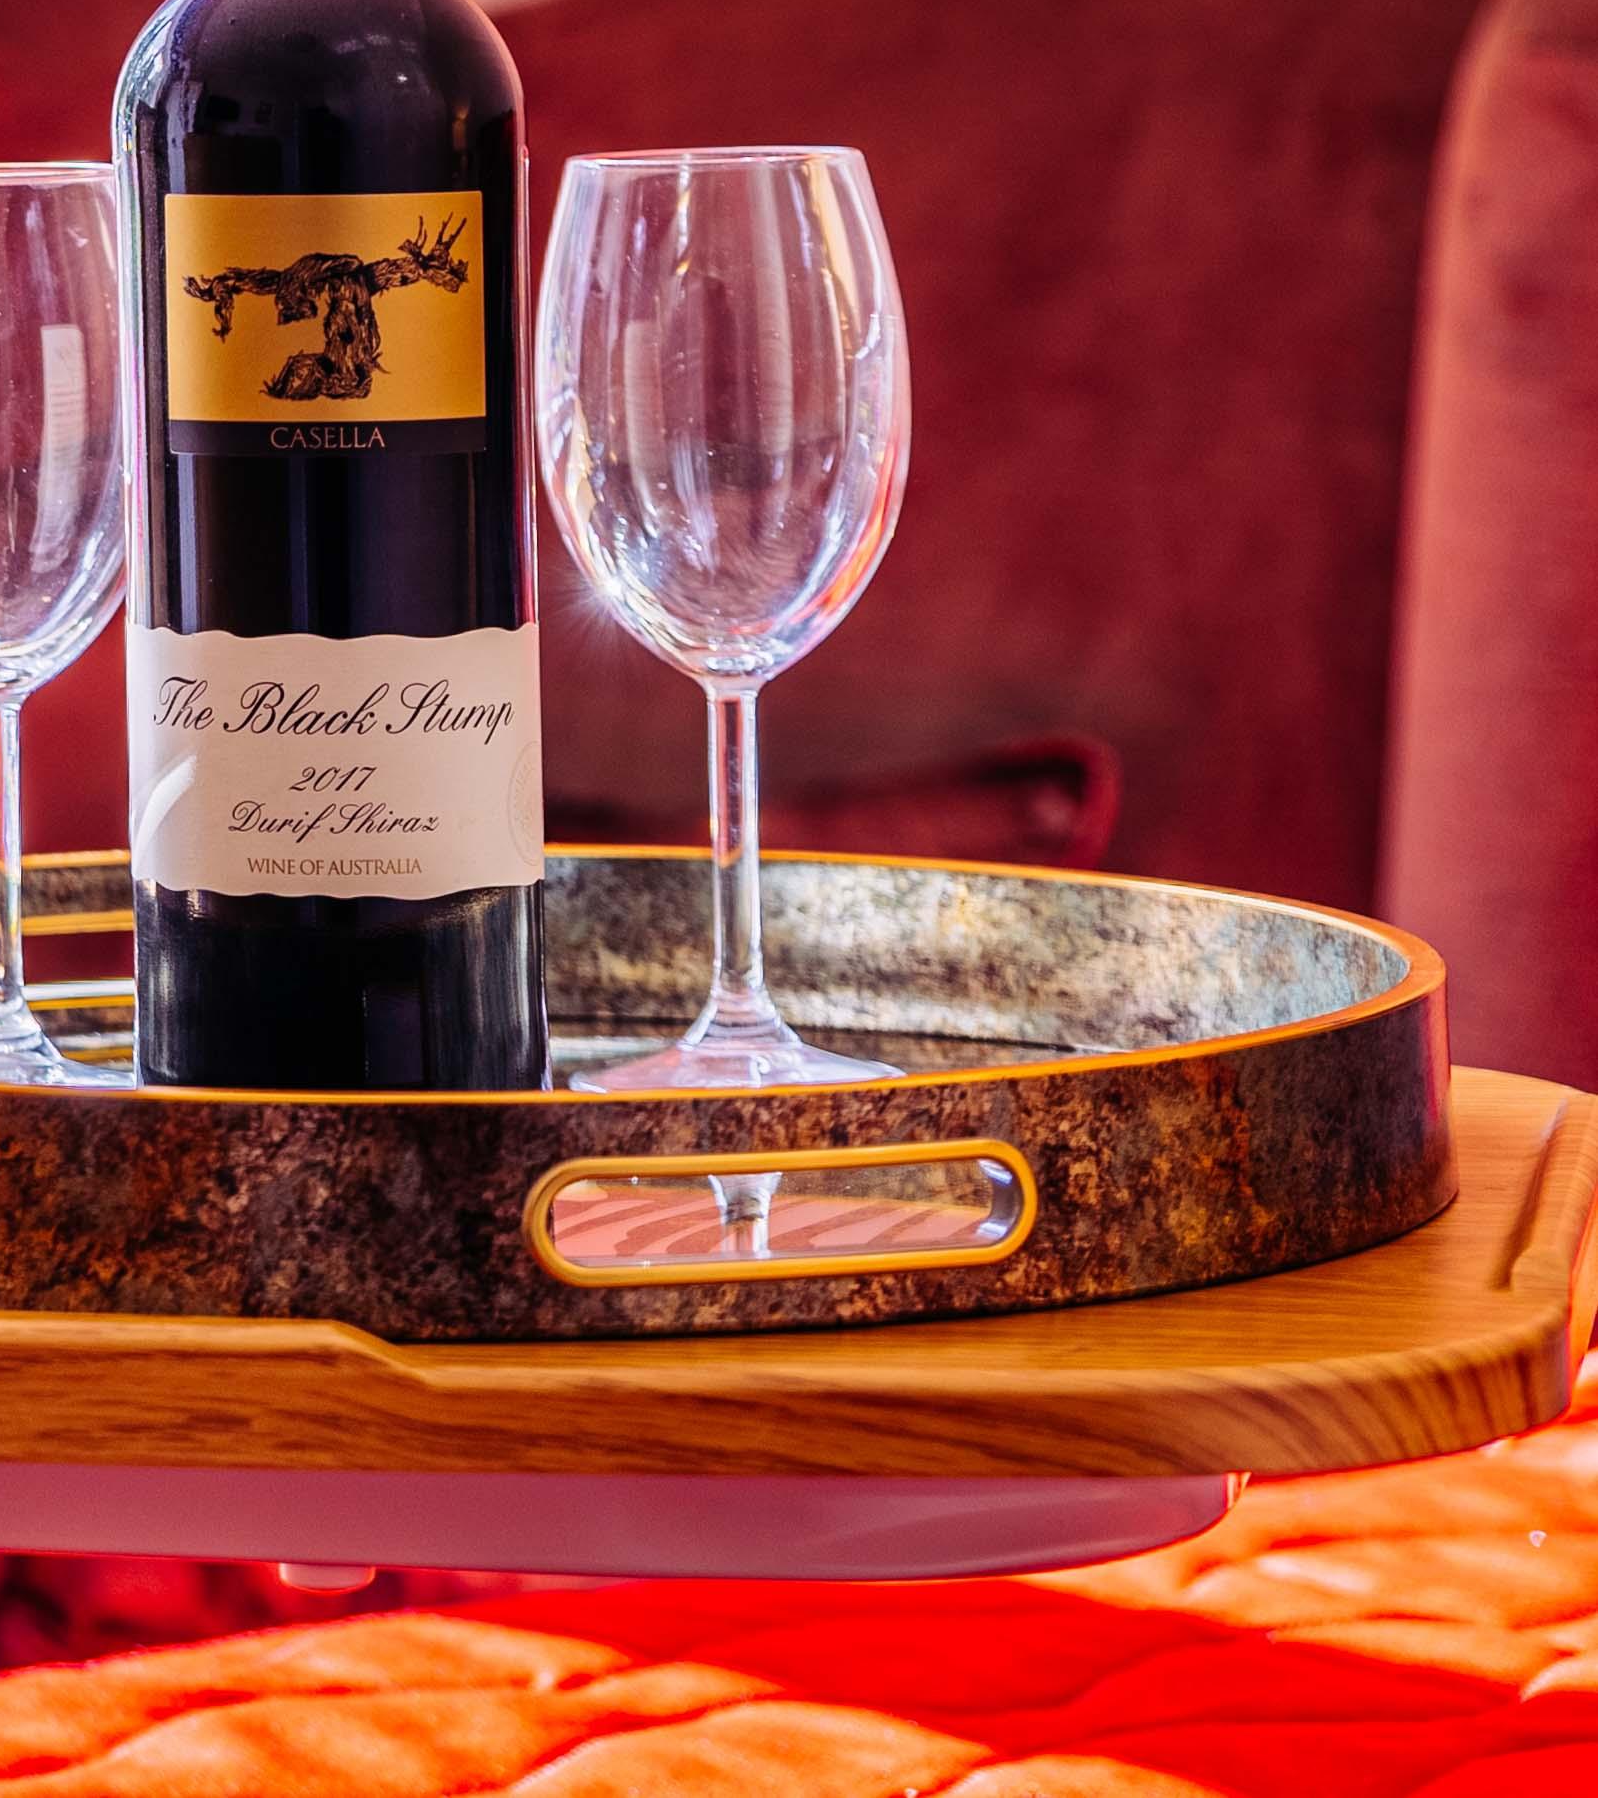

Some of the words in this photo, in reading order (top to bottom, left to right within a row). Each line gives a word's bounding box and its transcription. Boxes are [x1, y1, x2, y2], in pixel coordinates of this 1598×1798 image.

[270, 426, 386, 450] CASELLA
[154, 676, 215, 731] The
[222, 680, 391, 736] Black
[385, 679, 515, 745] Stump
[288, 766, 378, 793] 2017
[227, 800, 337, 844] Durif
[329, 802, 441, 835] Shiraz
[246, 857, 297, 875] WINE
[299, 858, 325, 876] OF
[327, 857, 423, 876] AUSTRALIA
